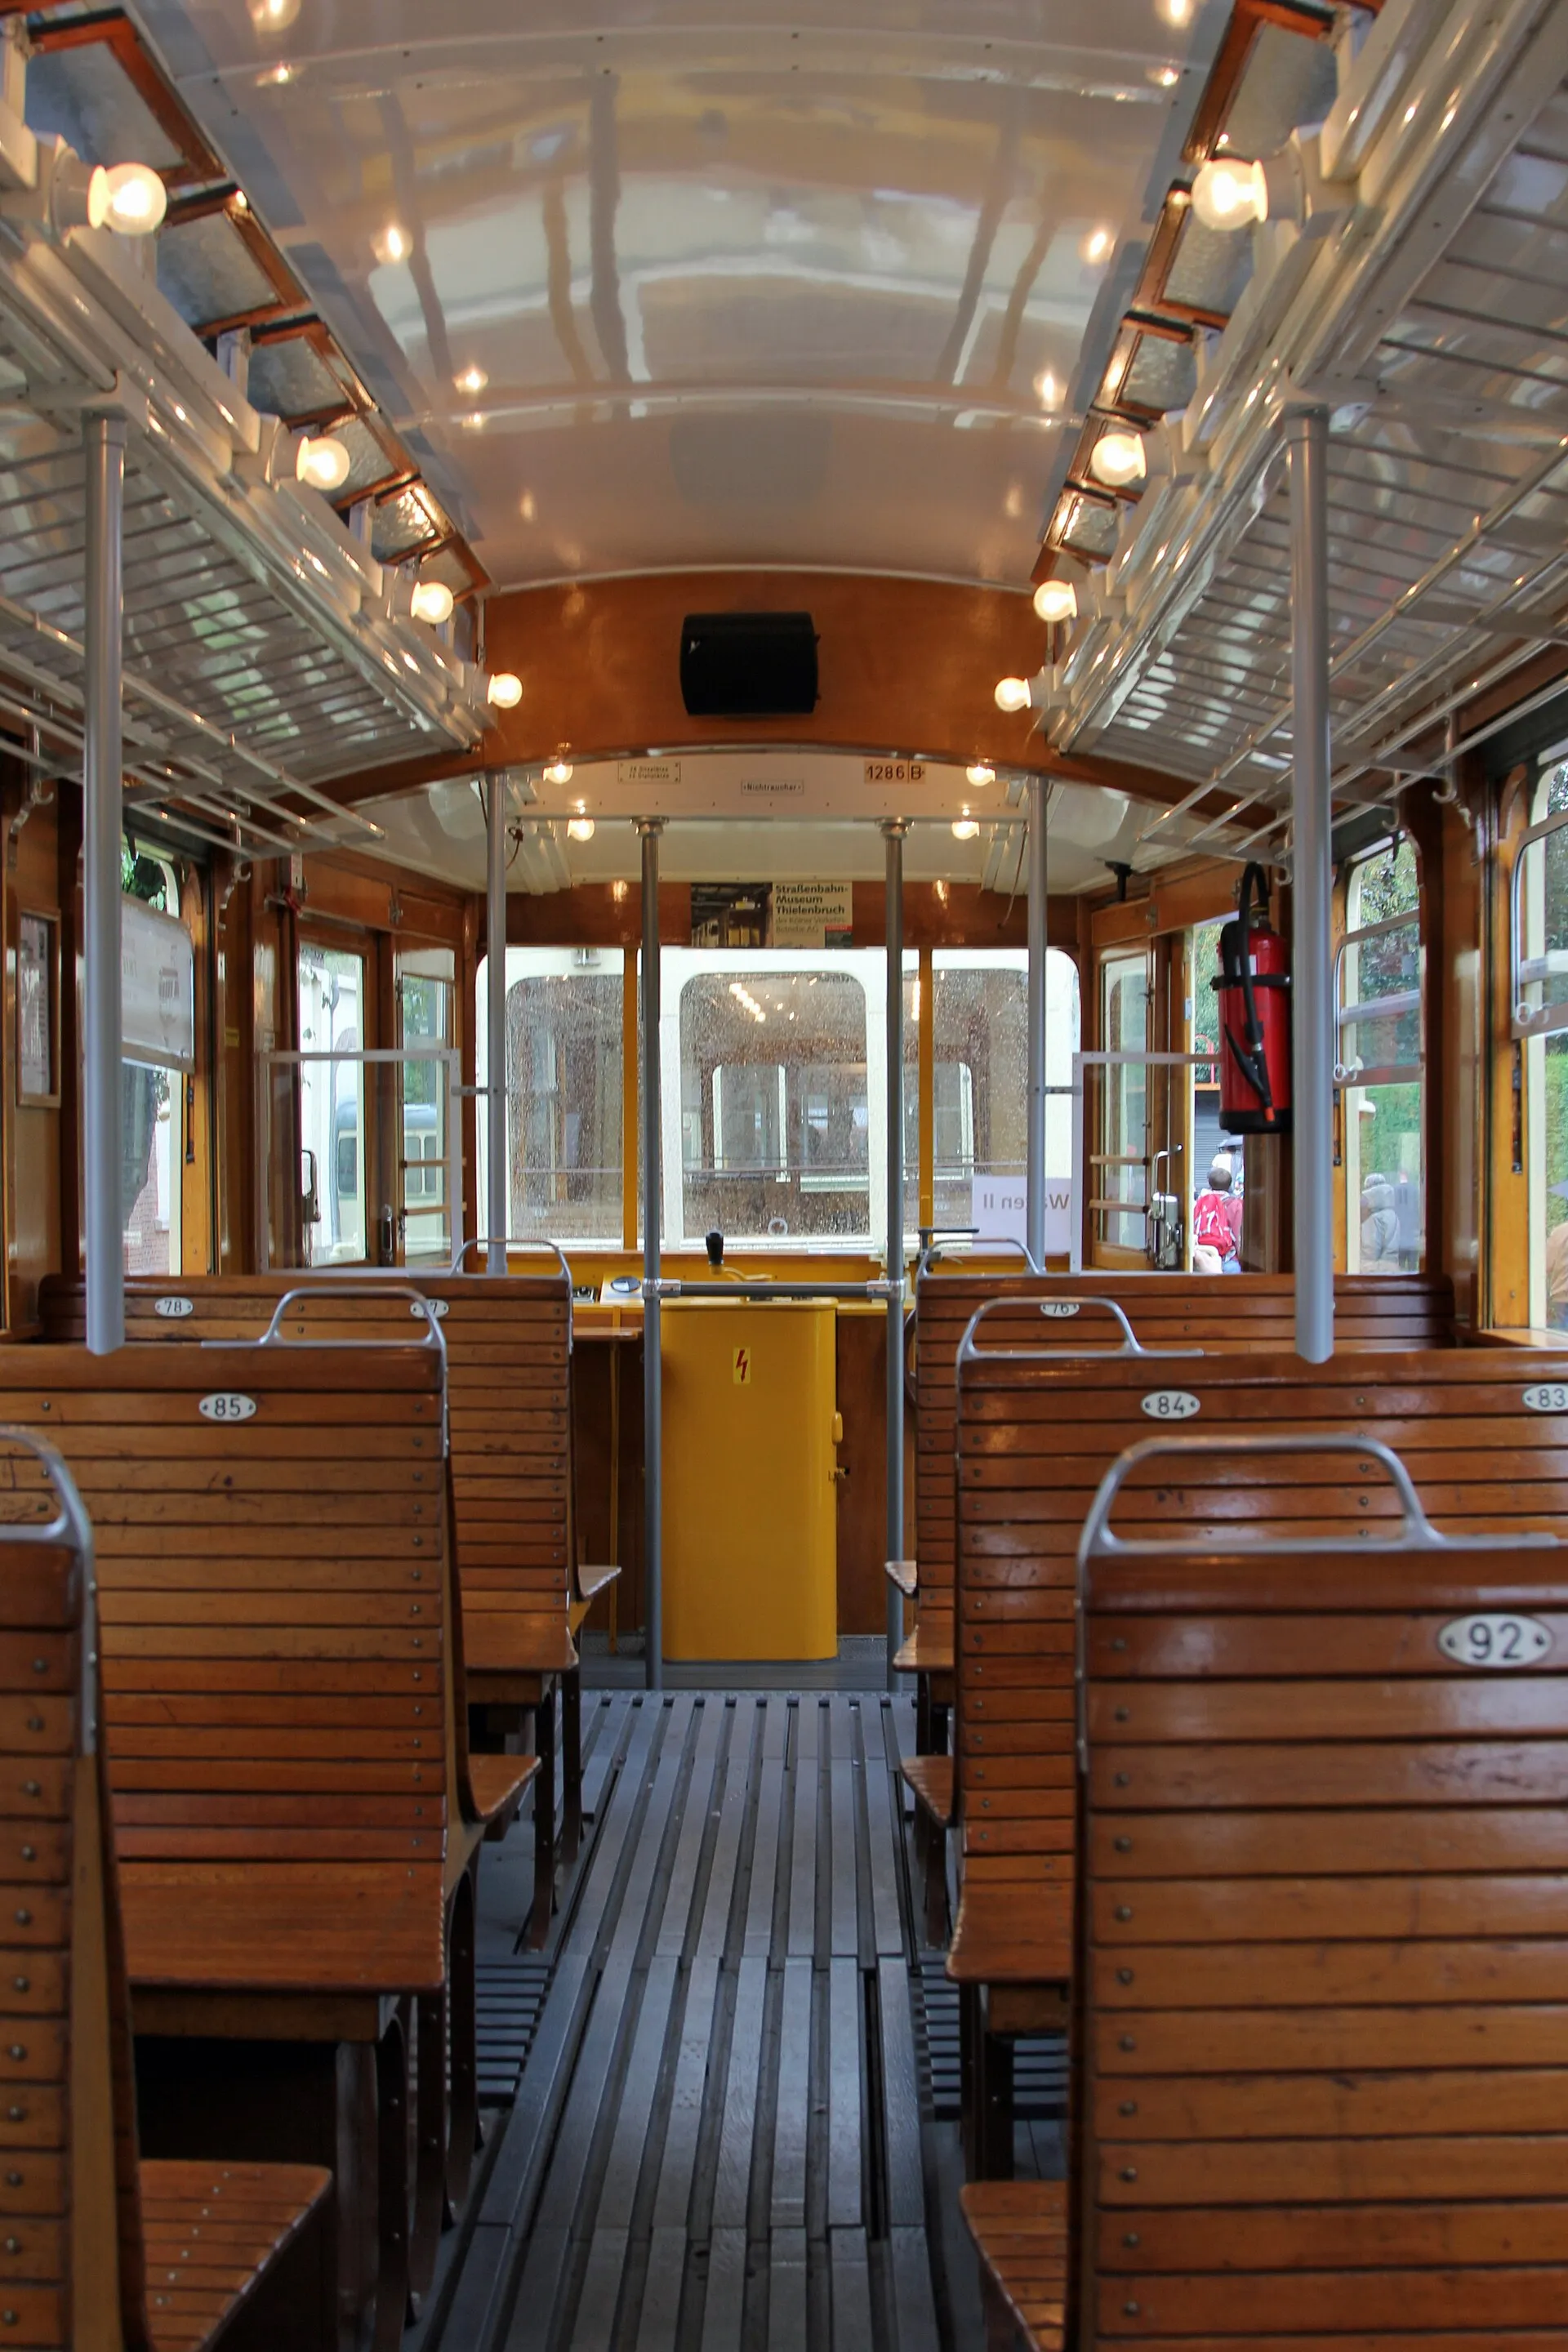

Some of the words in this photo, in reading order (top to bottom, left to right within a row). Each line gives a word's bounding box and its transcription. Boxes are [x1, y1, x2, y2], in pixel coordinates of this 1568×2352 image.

[867, 764, 905, 780] 1286
[911, 764, 921, 780] B
[776, 883, 849, 894] Straßenbahn-
[776, 895, 823, 904] Museum
[776, 904, 845, 915] Thielenbruch
[165, 1298, 182, 1314] 78
[1158, 1395, 1185, 1415] 84
[1539, 1388, 1566, 1408] 83
[215, 1396, 241, 1418] 85
[1469, 1622, 1522, 1660] 92
